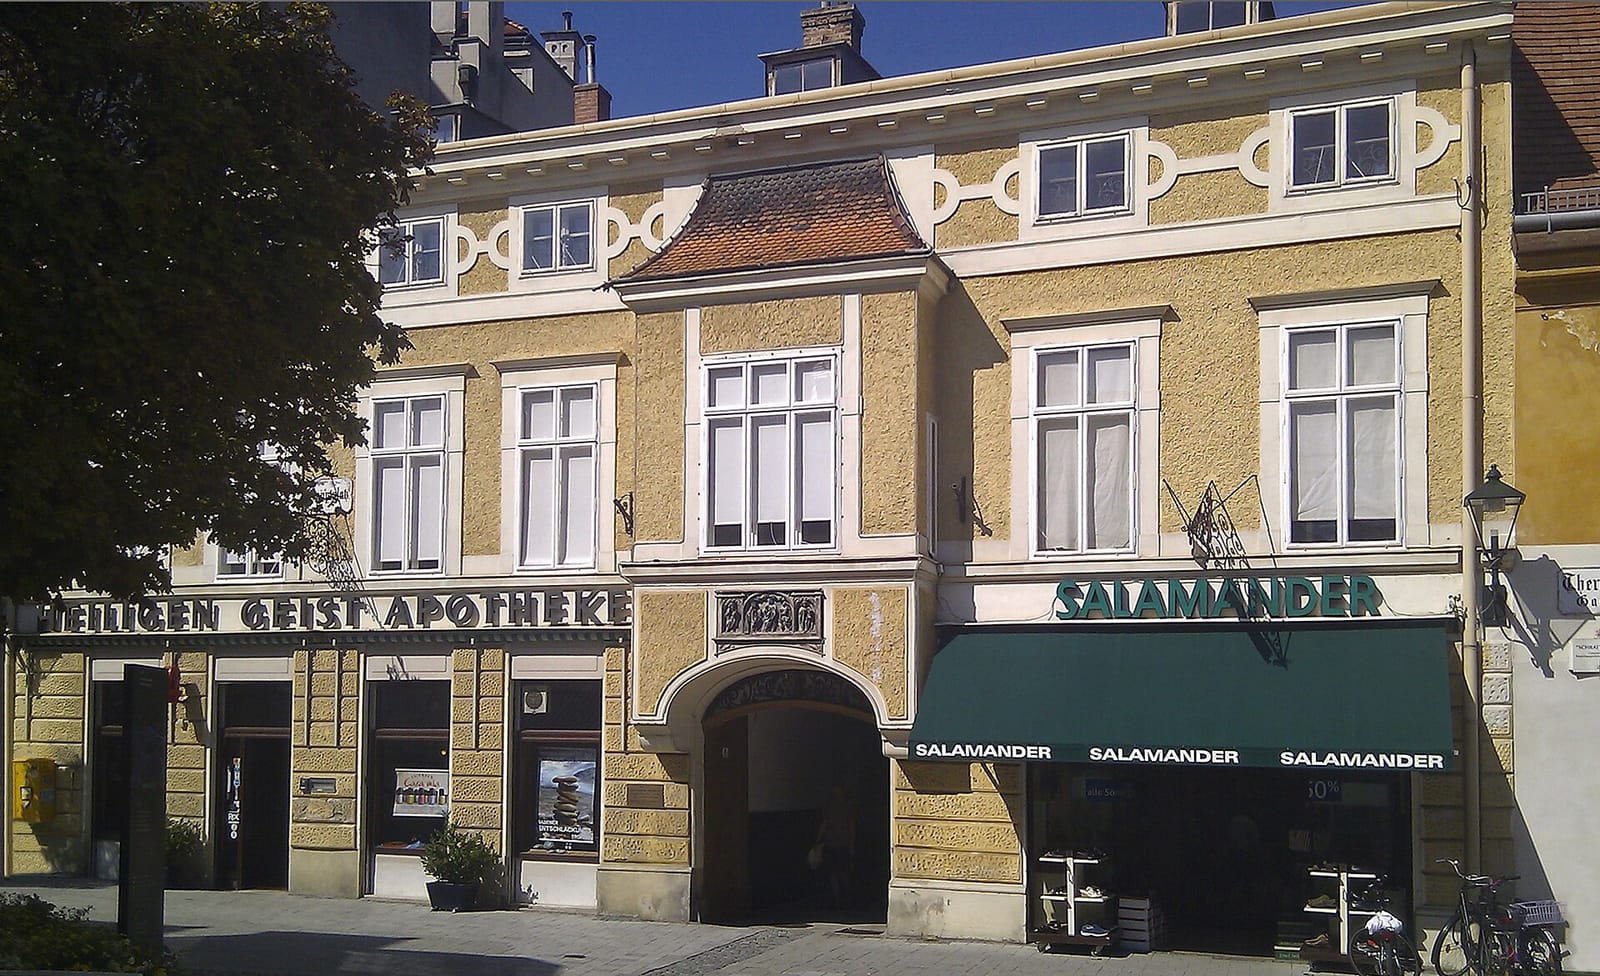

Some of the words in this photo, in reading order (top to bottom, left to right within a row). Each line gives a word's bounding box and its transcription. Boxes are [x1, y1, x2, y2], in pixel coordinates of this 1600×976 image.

[1056, 575, 1383, 619] SALAMANDER
[40, 600, 220, 632] HEILIGEN
[240, 597, 366, 630] GEIST
[383, 590, 632, 628] APOTHEKE
[915, 743, 1052, 760] SALAMANDER
[1089, 747, 1239, 764] SALAMANDER
[1280, 752, 1444, 769] SALAMANDER
